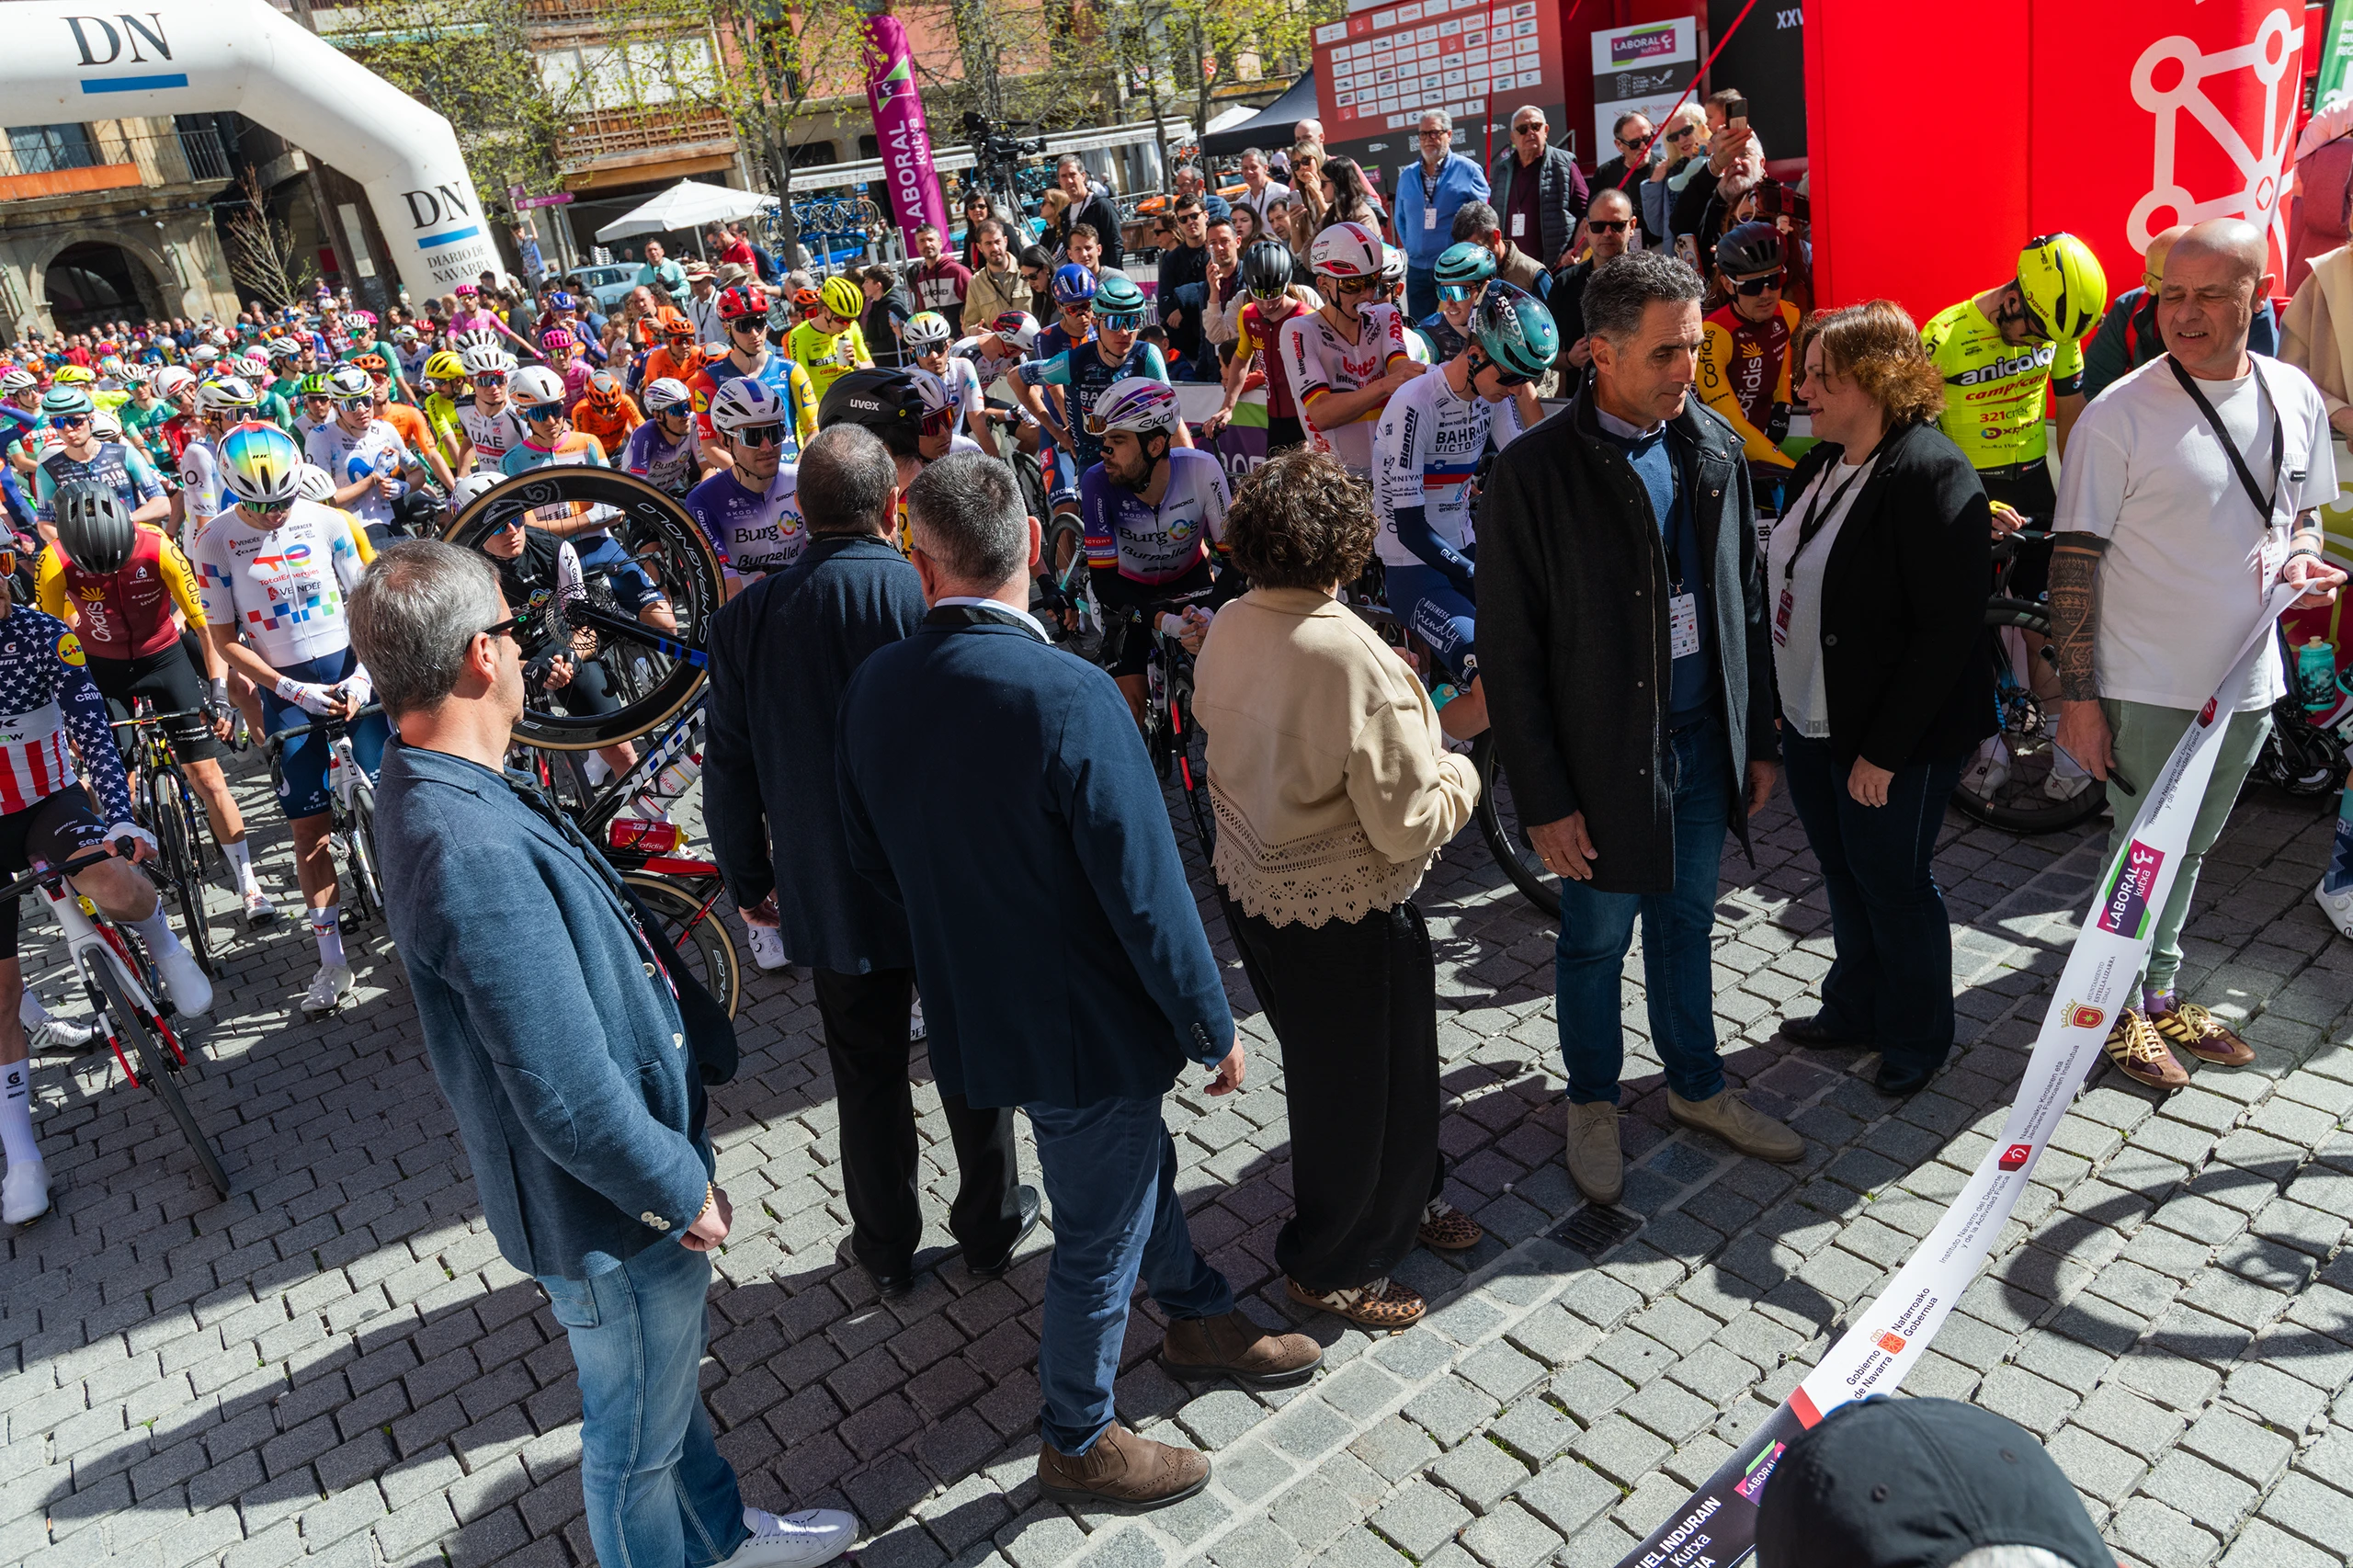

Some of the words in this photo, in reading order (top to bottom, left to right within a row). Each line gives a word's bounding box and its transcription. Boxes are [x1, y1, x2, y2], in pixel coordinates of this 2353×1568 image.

[59, 13, 173, 65] DN
[1614, 36, 1660, 51] LABORAL
[401, 181, 469, 229] DN
[426, 249, 472, 268] DIARIO
[472, 244, 487, 256] DE
[432, 259, 493, 284] NAVARRA
[1497, 295, 1527, 348] RUDY
[849, 399, 880, 412] uvex
[471, 430, 505, 449] UAE
[1399, 405, 1415, 470] Bianchi
[1436, 416, 1492, 444] BAHRAIN
[1168, 498, 1195, 511] SIROKO
[236, 536, 261, 547] VENDÉE
[289, 523, 313, 532] BIORACER
[697, 510, 713, 540] CORTIZO
[1757, 524, 1771, 541] 181
[170, 546, 200, 605] Cofidis
[258, 569, 320, 586] TotalEnergies
[1424, 599, 1450, 619] BUSINESS
[340, 744, 358, 777] CUBE
[2149, 796, 2165, 825] Instituto
[2162, 768, 2177, 796] Navarro
[2175, 756, 2183, 767] del
[2180, 727, 2197, 756] Deporte
[2174, 752, 2191, 785] Actividad
[2106, 867, 2140, 929] LABORAL
[2133, 869, 2151, 897] kutxa
[2086, 961, 2105, 1002] AYUNTAMIENTO
[2094, 956, 2116, 1004] ESTELLA-LIZARRA
[2101, 987, 2112, 1005] UDALA
[2019, 1103, 2043, 1140] Nafarroako
[2040, 1074, 2059, 1105] Kirolaren
[2055, 1061, 2064, 1074] eta
[2028, 1111, 2047, 1141] Jarduera
[2042, 1077, 2063, 1111] Fisikoaren
[2060, 1045, 2080, 1077] Institutua
[1938, 1238, 1961, 1265] Instituto
[1957, 1212, 1979, 1238] Navarro
[1976, 1200, 1985, 1212] del
[1983, 1175, 2003, 1200] Deporte
[1965, 1235, 1974, 1244] de
[1975, 1196, 1998, 1227] Actividad
[1891, 1287, 1930, 1333] Nafarroako
[1903, 1296, 1938, 1337] Gobernua
[1846, 1349, 1881, 1386] Gobierno
[1854, 1387, 1867, 1400] de
[1861, 1355, 1893, 1389] Navarra
[1659, 1495, 1722, 1553] INDURAIN
[1669, 1533, 1712, 1568] Kutxa
